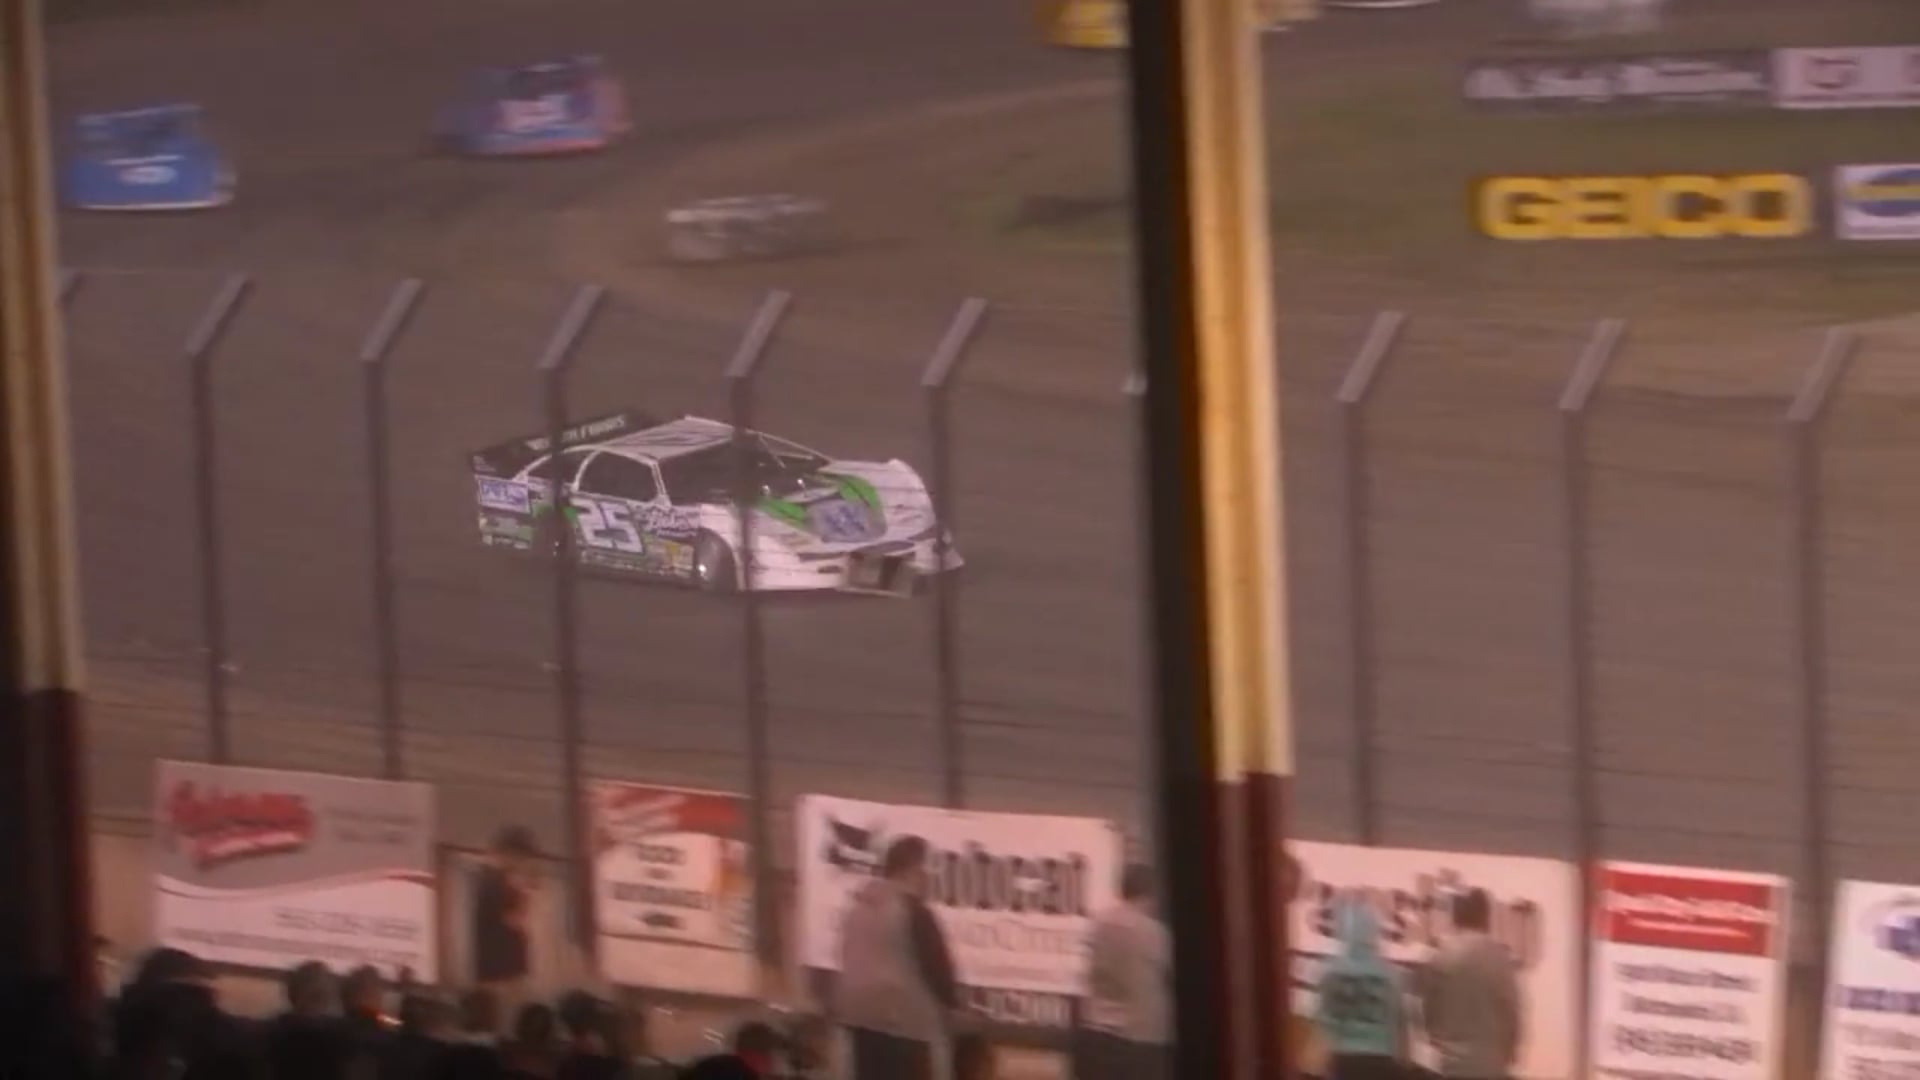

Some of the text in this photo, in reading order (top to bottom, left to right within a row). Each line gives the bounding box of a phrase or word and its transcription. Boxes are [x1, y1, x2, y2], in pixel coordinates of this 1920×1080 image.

[1478, 174, 1811, 239] GEICO
[570, 498, 643, 553] 25
[918, 839, 1088, 916] obcat
